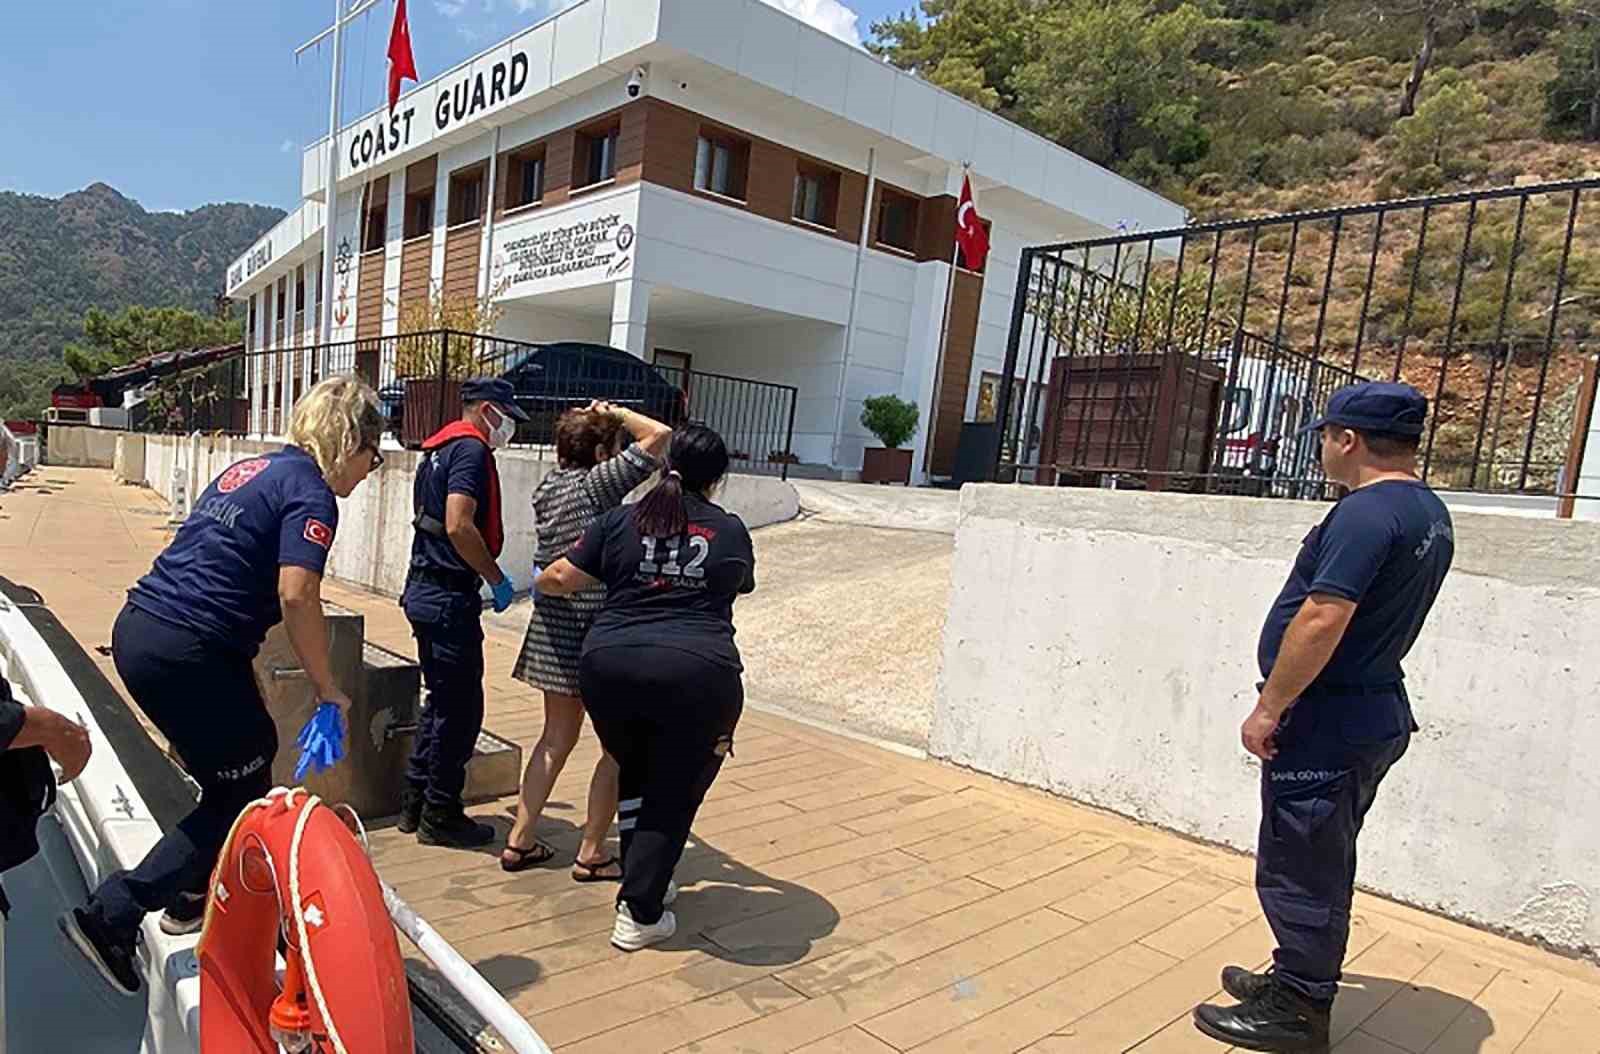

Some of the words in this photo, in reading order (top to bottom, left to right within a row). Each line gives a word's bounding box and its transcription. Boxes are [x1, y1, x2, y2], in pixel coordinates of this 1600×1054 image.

[350, 107, 416, 168] COAST
[435, 52, 528, 130] GUARD
[639, 535, 709, 577] 112
